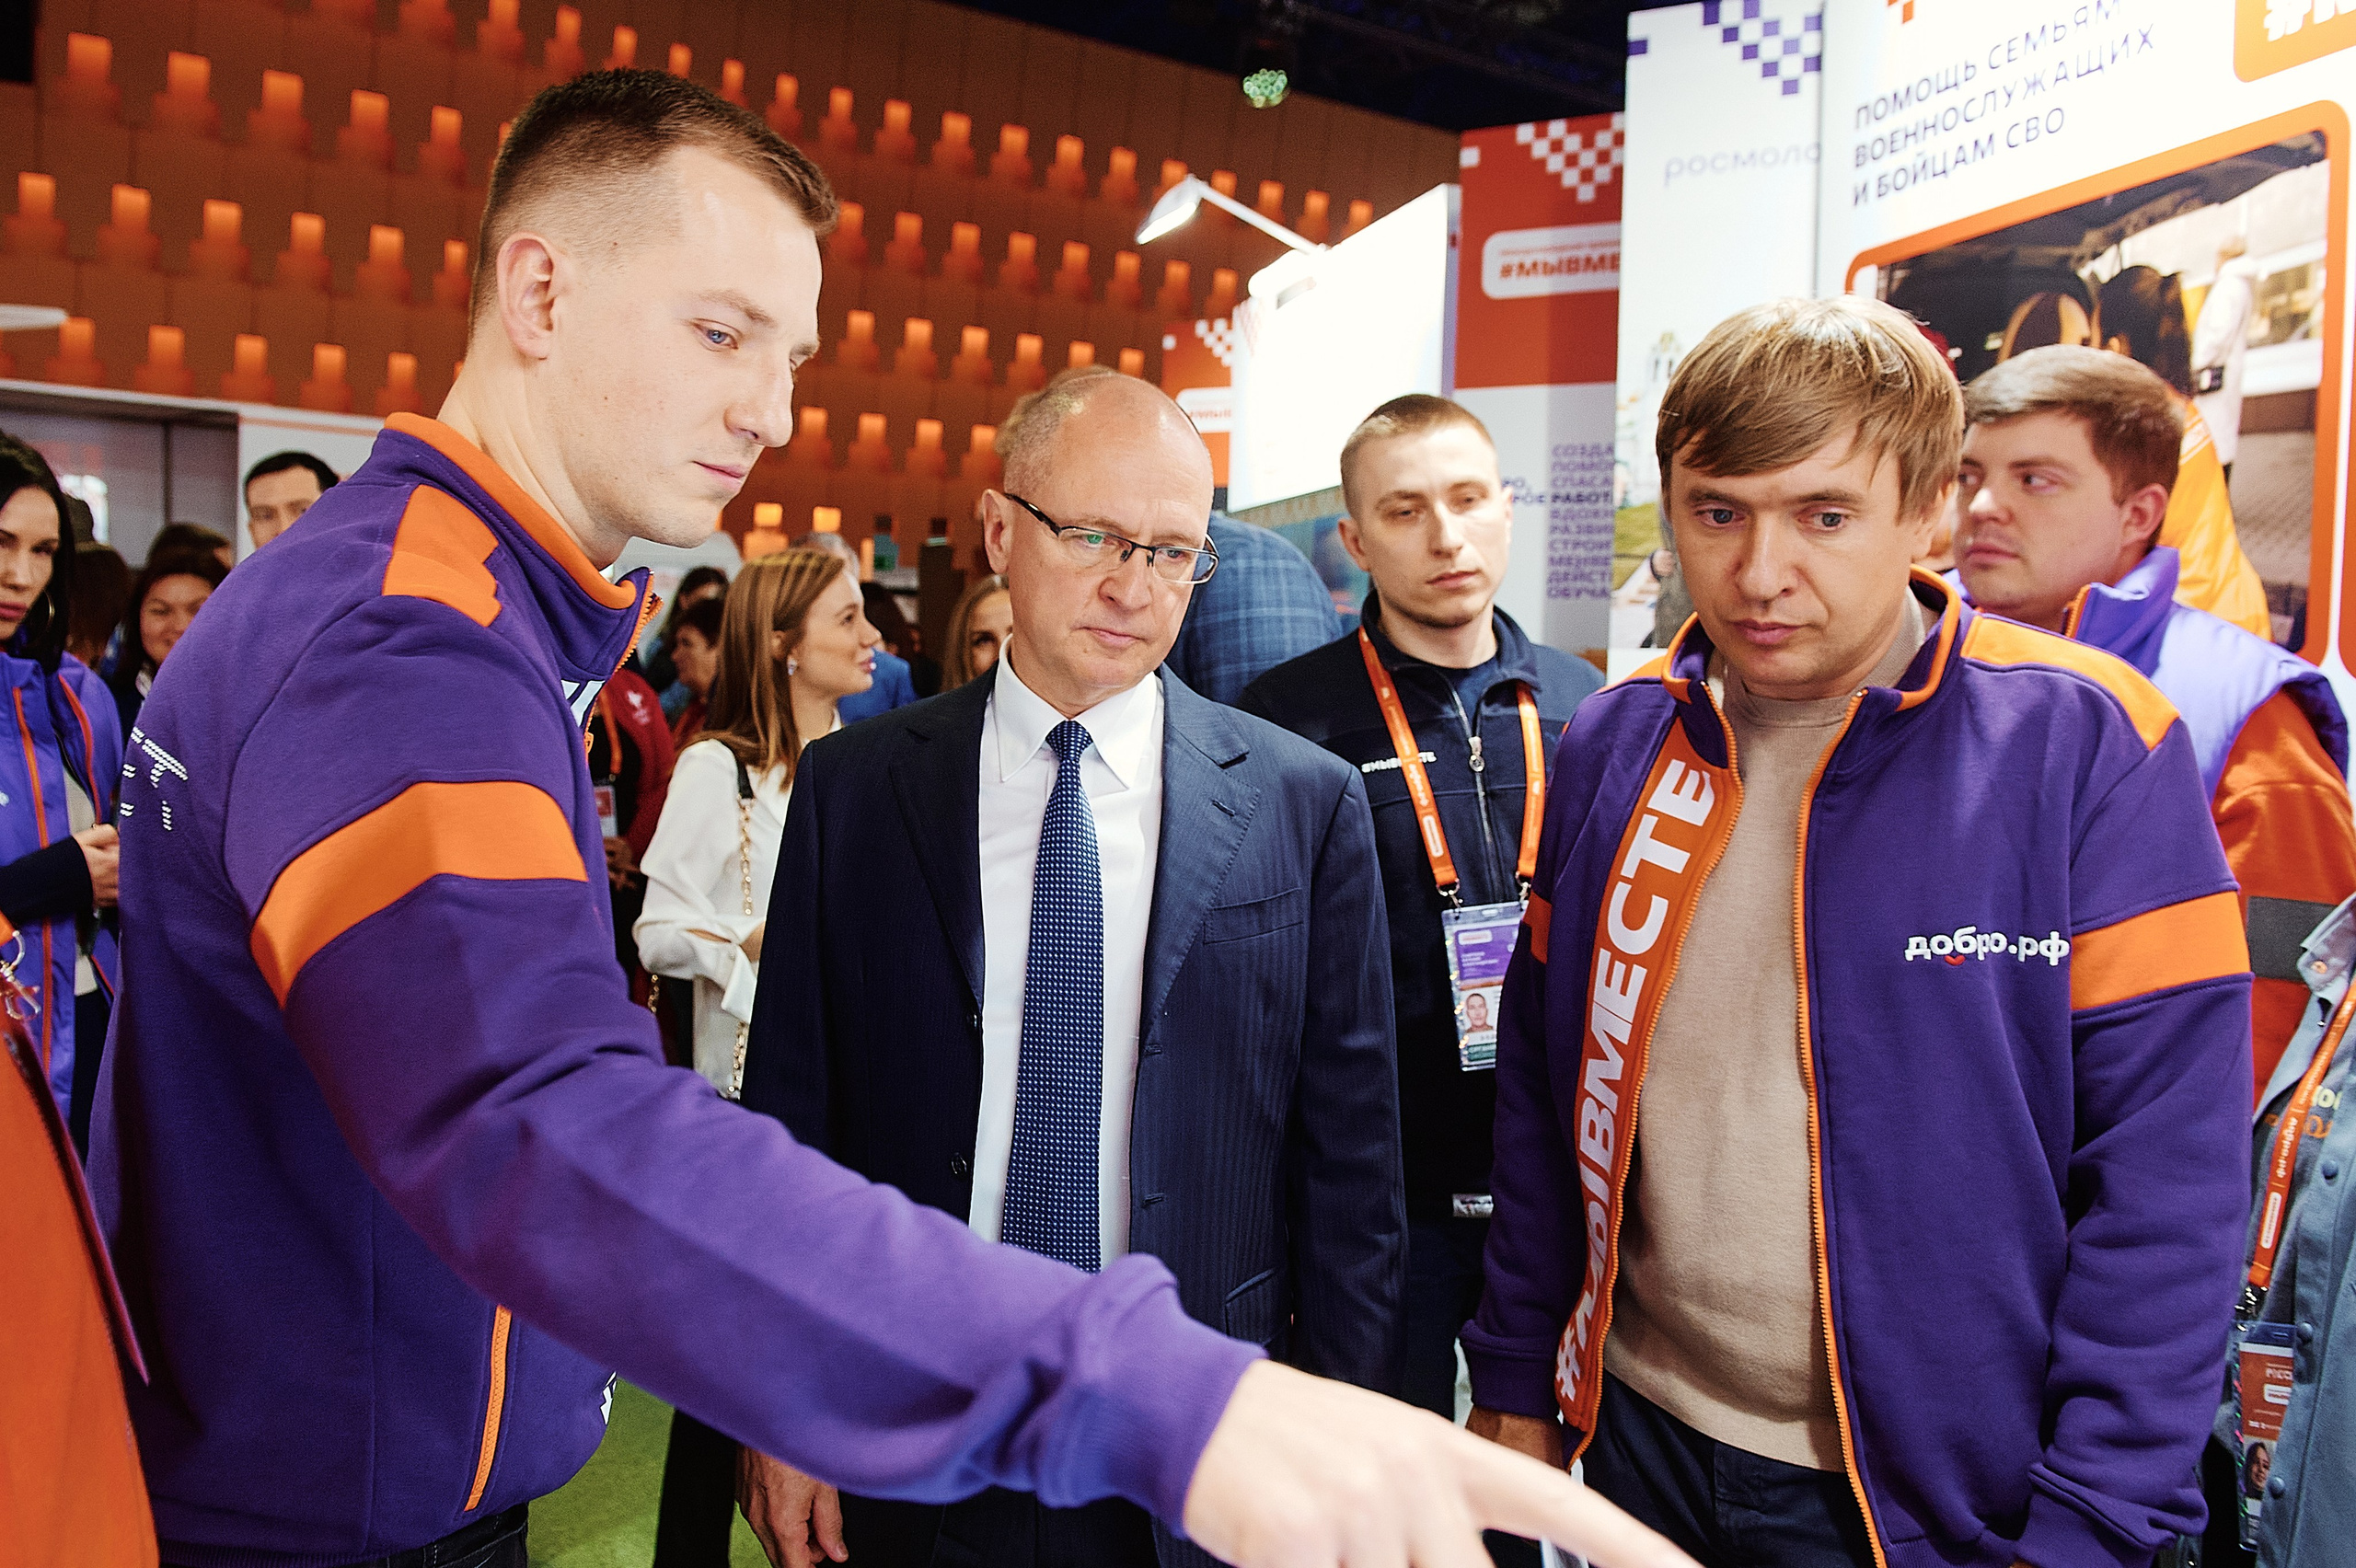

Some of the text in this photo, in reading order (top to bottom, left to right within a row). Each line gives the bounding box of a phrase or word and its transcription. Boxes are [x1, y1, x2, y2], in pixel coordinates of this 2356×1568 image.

[1854, 22, 2154, 167] ВОЕННОСЛУЖАЩИХ
[1855, 0, 2120, 130] ПОМОЩЬ СЕМЬЯМ
[1854, 107, 2065, 207] И БОЙЦАМ СВО
[1551, 491, 1613, 504] РАБОТ
[1904, 925, 2071, 966] добро.рф
